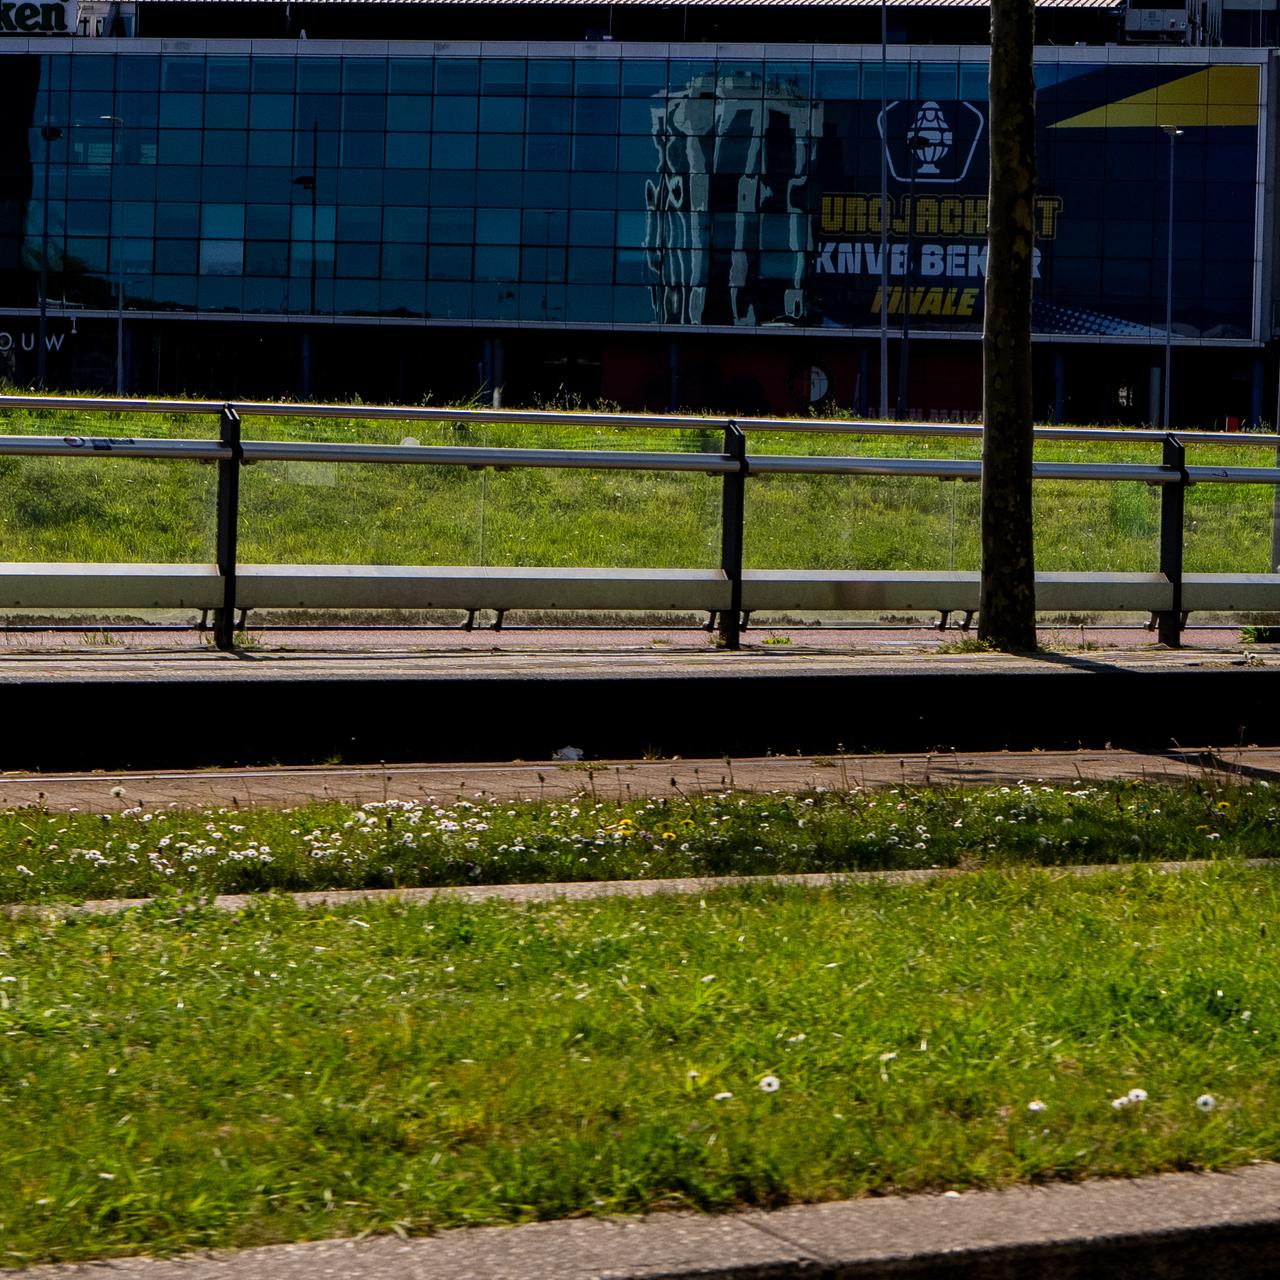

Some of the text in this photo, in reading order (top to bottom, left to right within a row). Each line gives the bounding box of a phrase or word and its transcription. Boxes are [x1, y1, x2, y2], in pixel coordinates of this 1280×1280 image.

[820, 195, 1060, 236] UROJACKT
[815, 241, 1042, 279] KNVB BEK
[870, 286, 980, 316] FINALE
